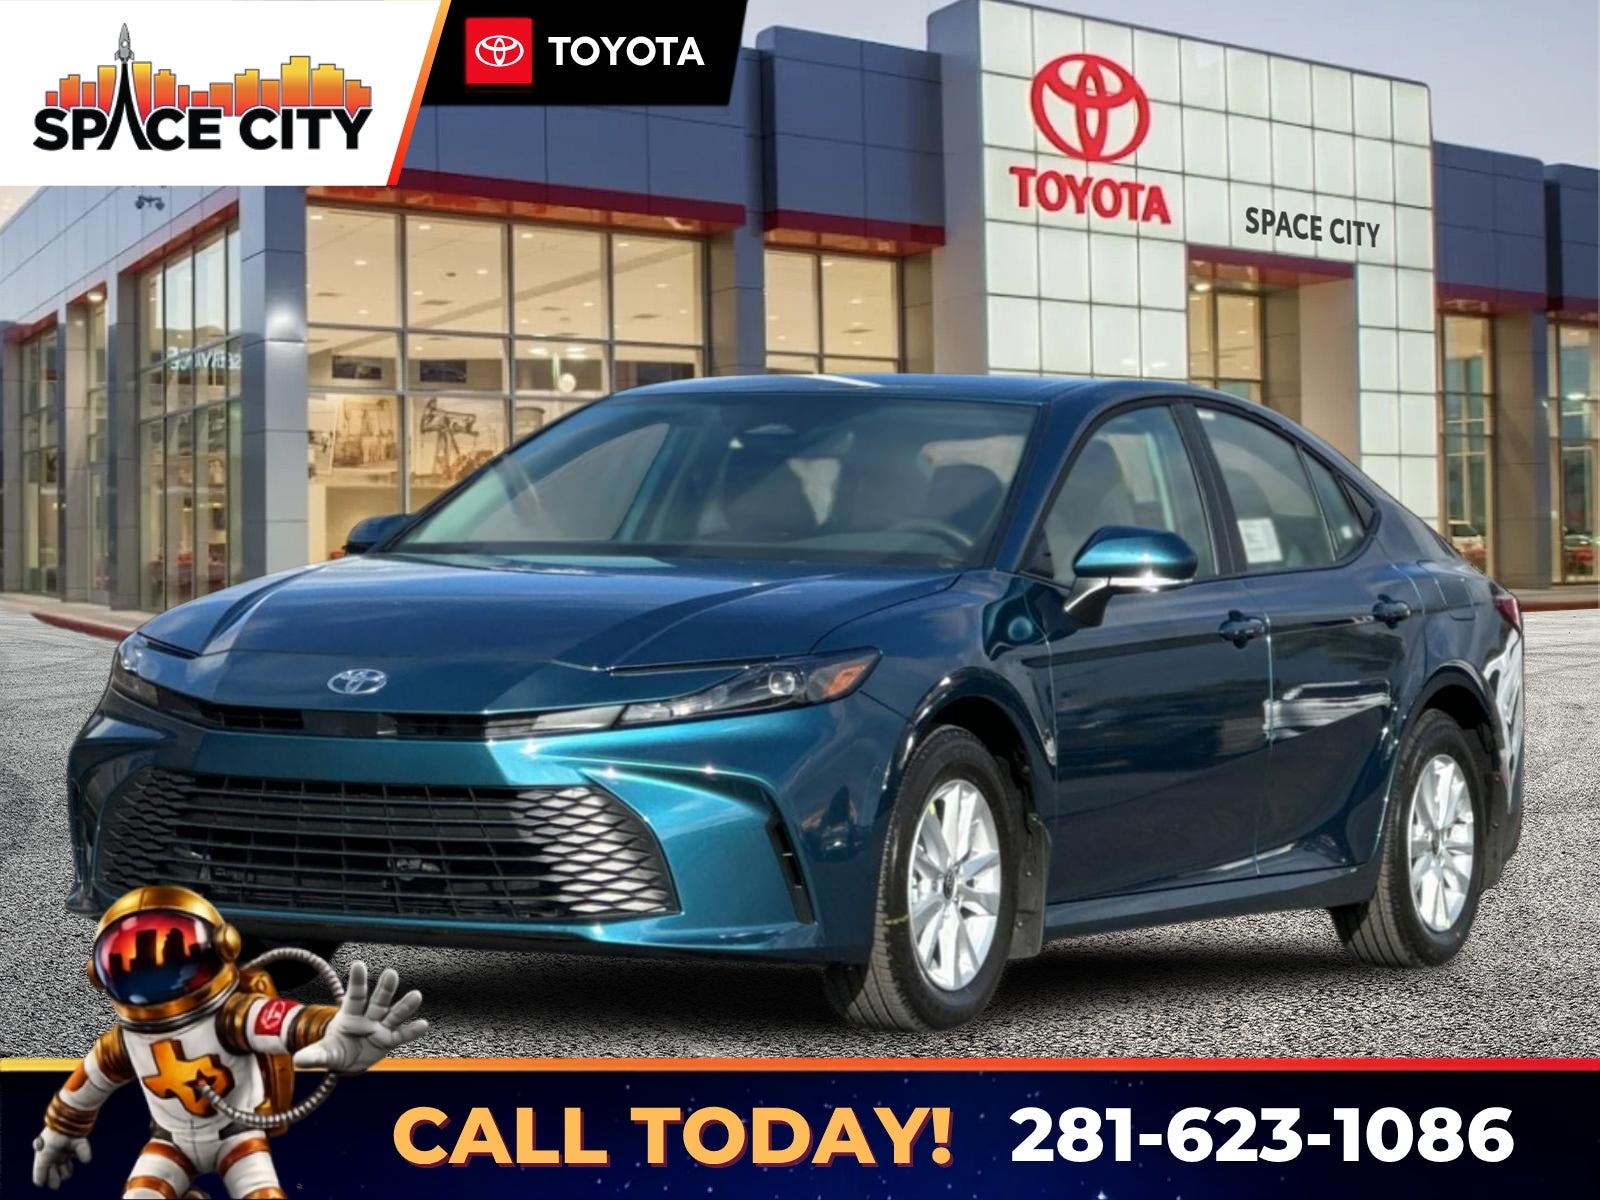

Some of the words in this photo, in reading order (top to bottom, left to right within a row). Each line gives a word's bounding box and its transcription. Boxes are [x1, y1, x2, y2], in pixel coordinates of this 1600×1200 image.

[1009, 166, 1171, 224] TOYOTA
[1245, 207, 1322, 242] SPACE
[1329, 218, 1380, 248] CITY
